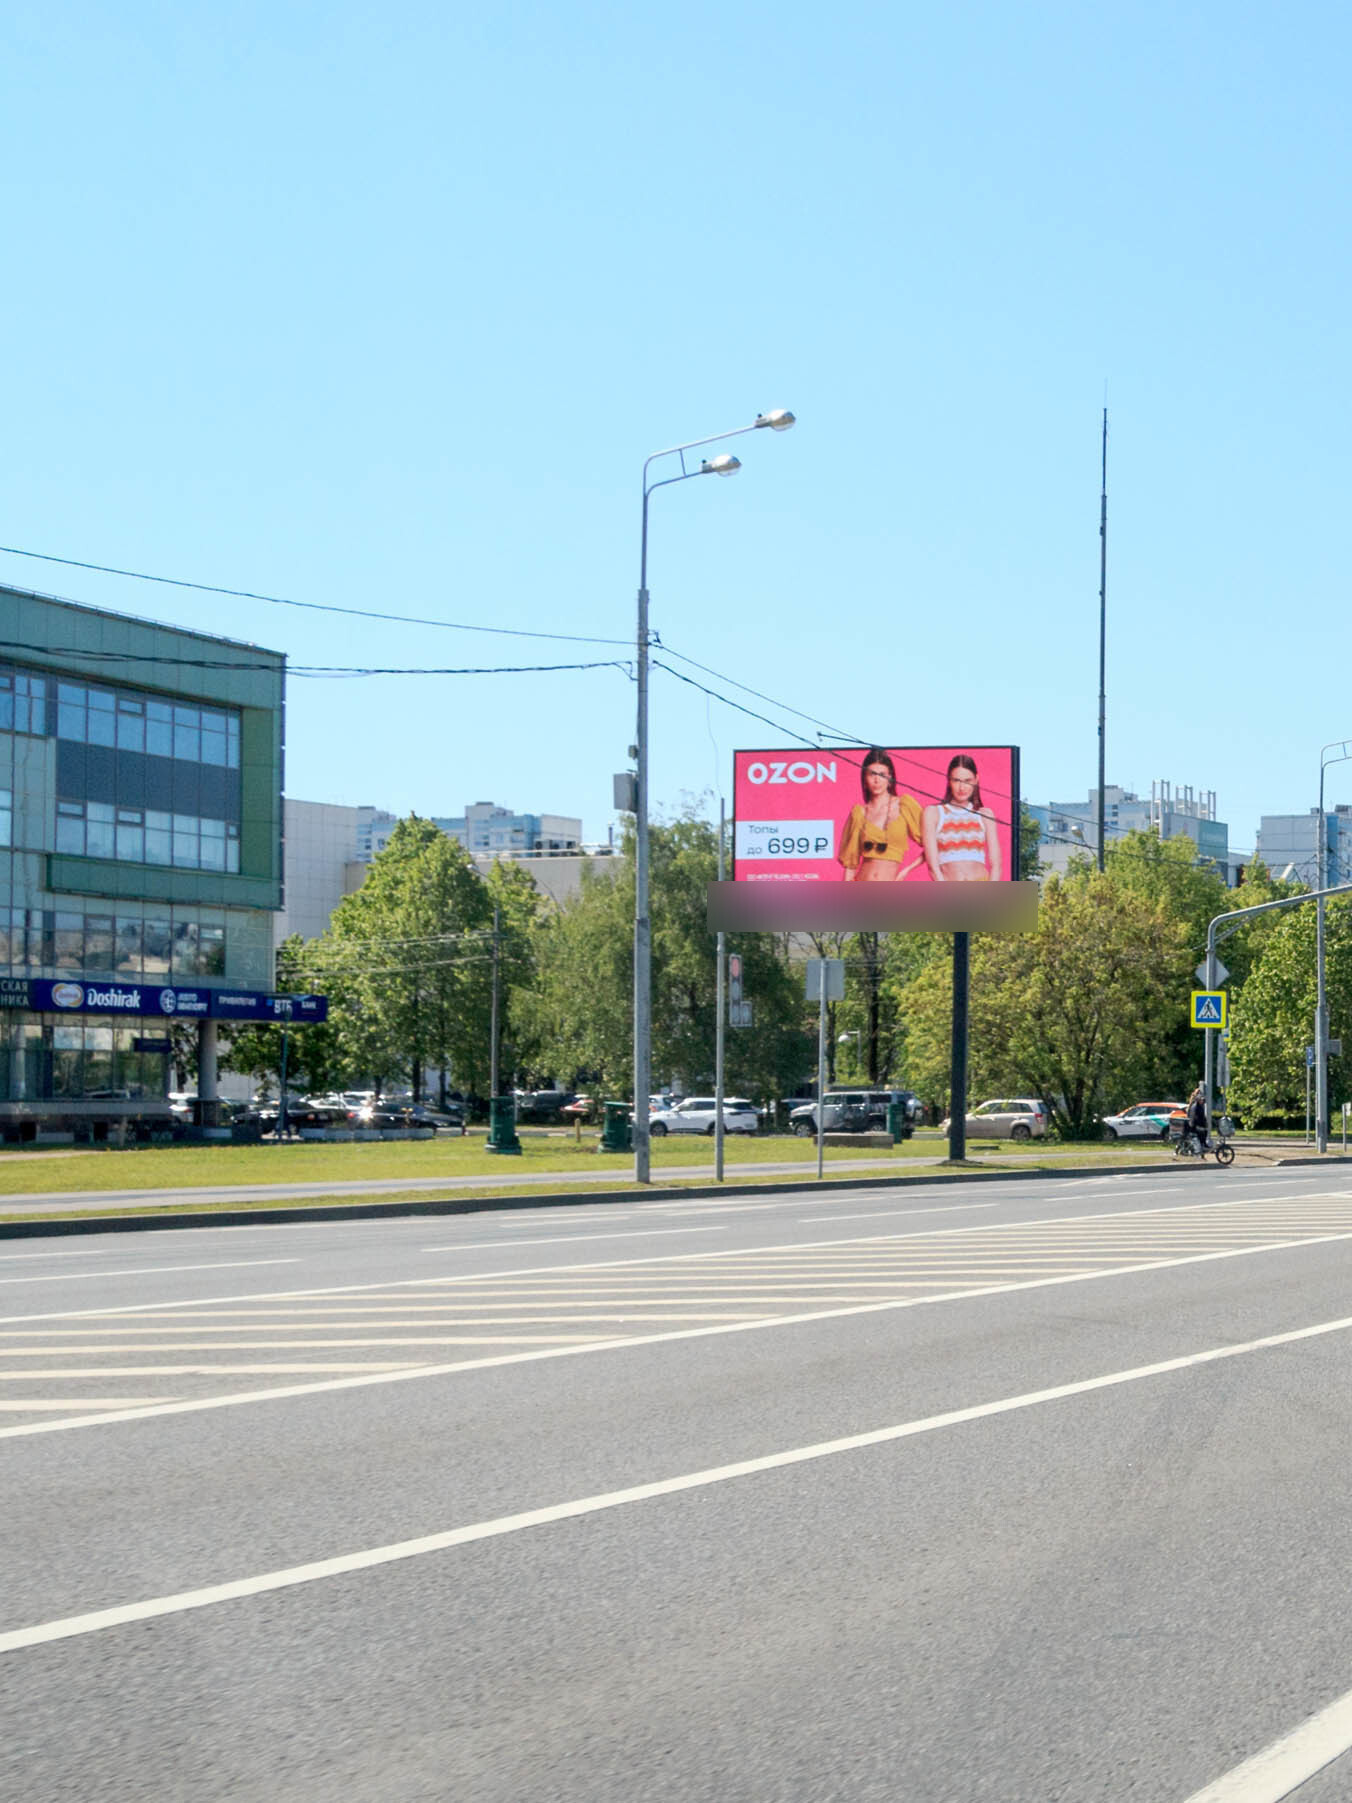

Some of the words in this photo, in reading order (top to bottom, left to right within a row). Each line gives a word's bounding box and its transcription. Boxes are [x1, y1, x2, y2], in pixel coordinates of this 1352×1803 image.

[748, 762, 836, 785] OZON
[748, 825, 779, 834] Топы
[747, 846, 763, 855] до
[767, 837, 810, 854] 699
[0, 980, 28, 992] СКАЯ
[87, 988, 140, 1008] Doshirak
[273, 999, 293, 1014] ВТБ
